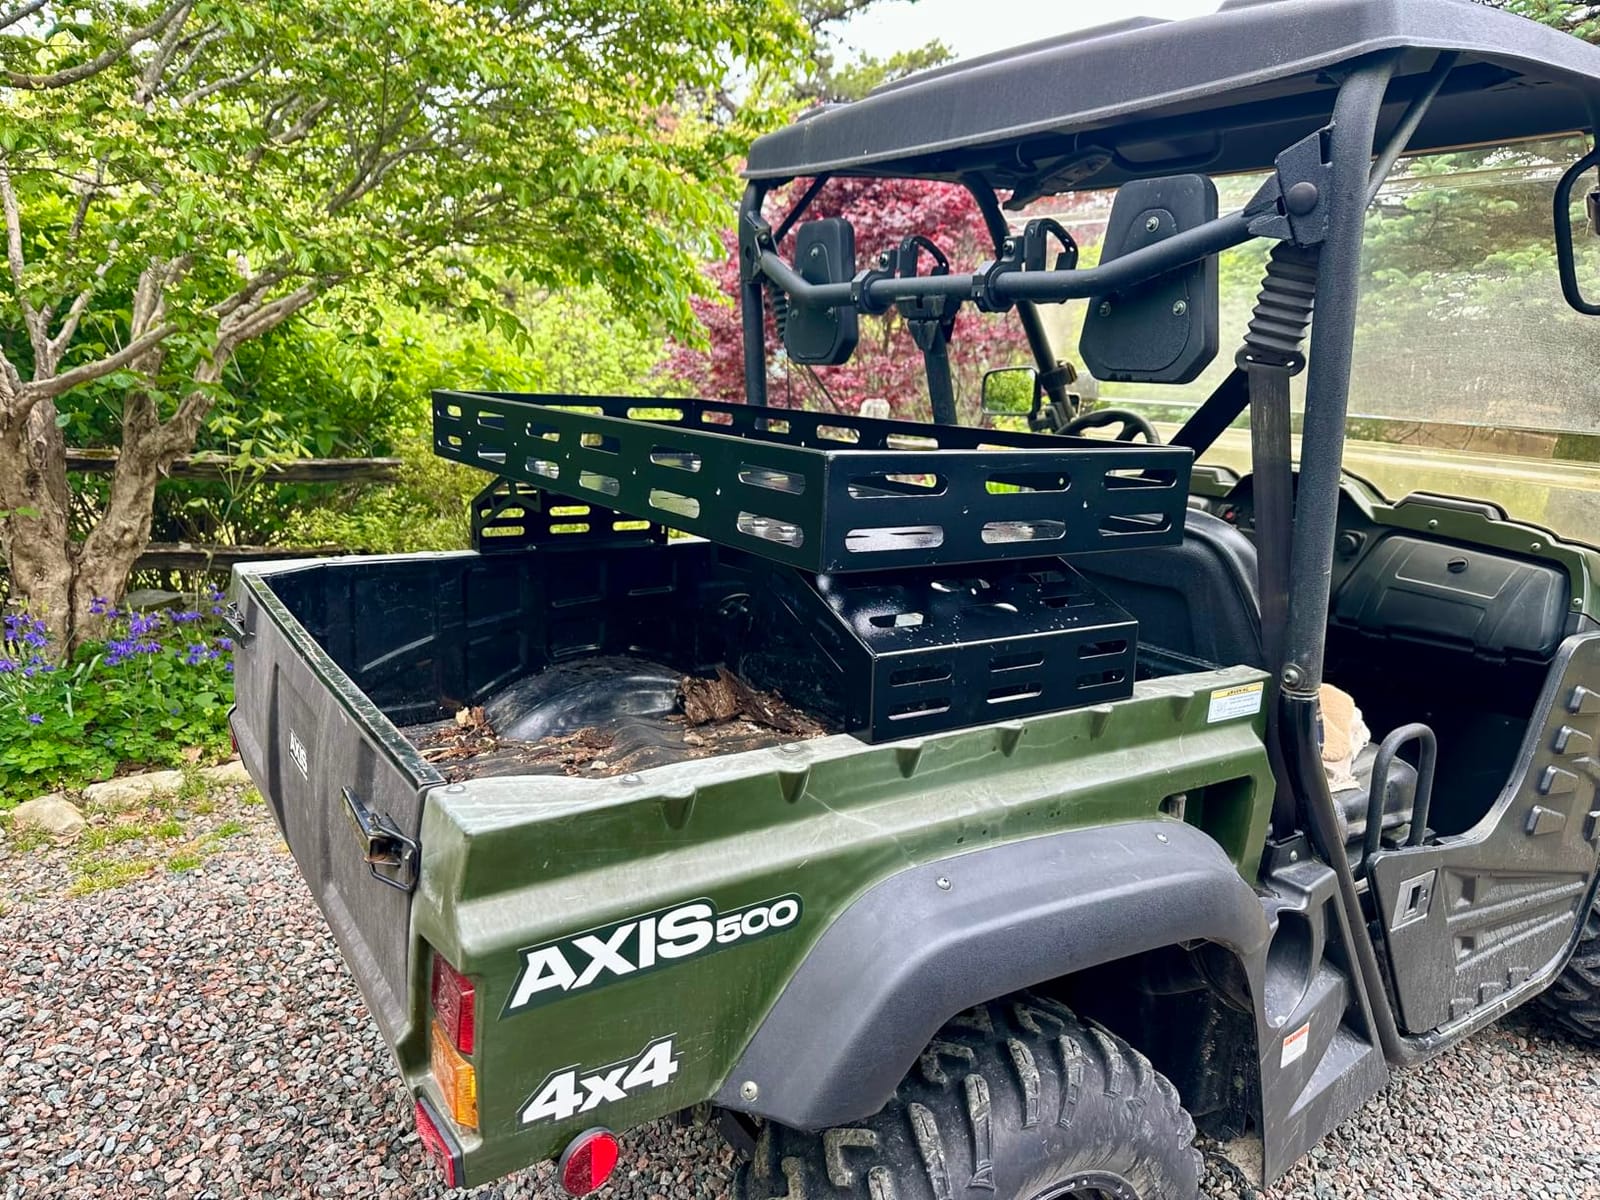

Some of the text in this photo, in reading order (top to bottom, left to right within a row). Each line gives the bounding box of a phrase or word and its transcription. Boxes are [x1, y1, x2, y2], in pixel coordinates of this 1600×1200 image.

[290, 732, 307, 773] AXIS
[509, 899, 798, 1009] AXIS 500
[522, 1040, 678, 1123] 4x4
